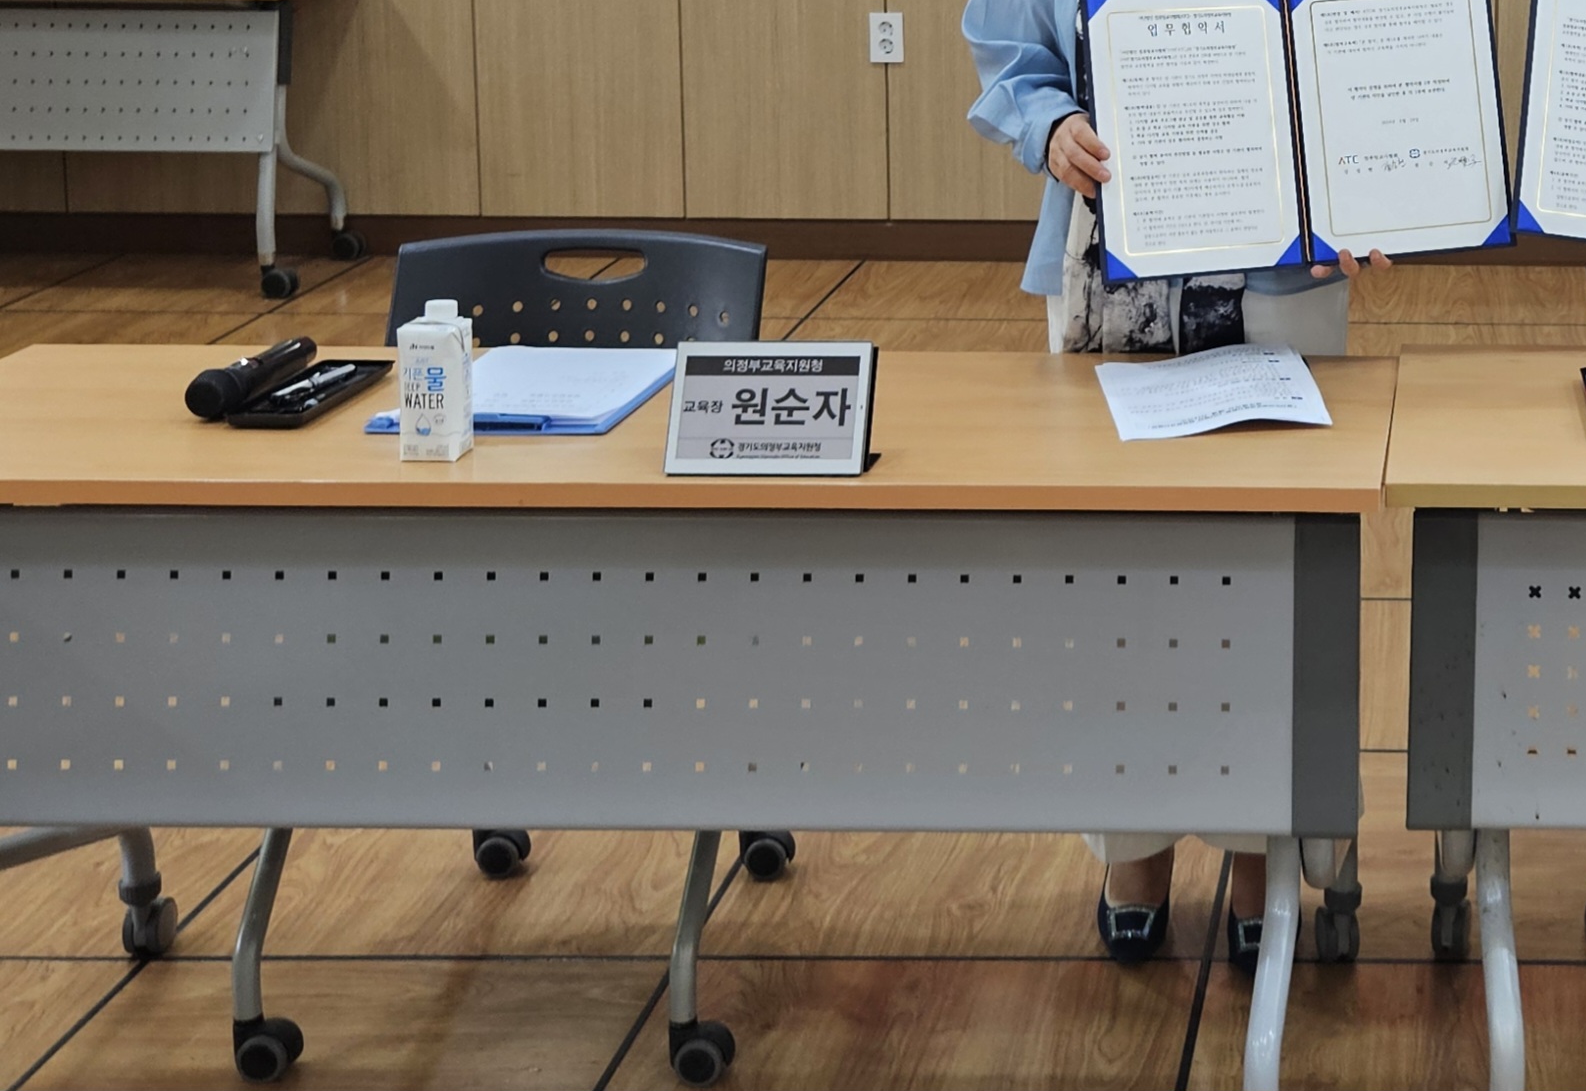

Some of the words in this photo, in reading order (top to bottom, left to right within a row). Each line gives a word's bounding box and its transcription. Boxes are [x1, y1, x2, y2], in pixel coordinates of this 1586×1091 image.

[1338, 155, 1360, 165] ATC
[722, 359, 823, 373] 의정부교육지원청
[404, 392, 444, 410] WATER
[683, 399, 723, 414] 교육장
[731, 387, 852, 427] 원순자
